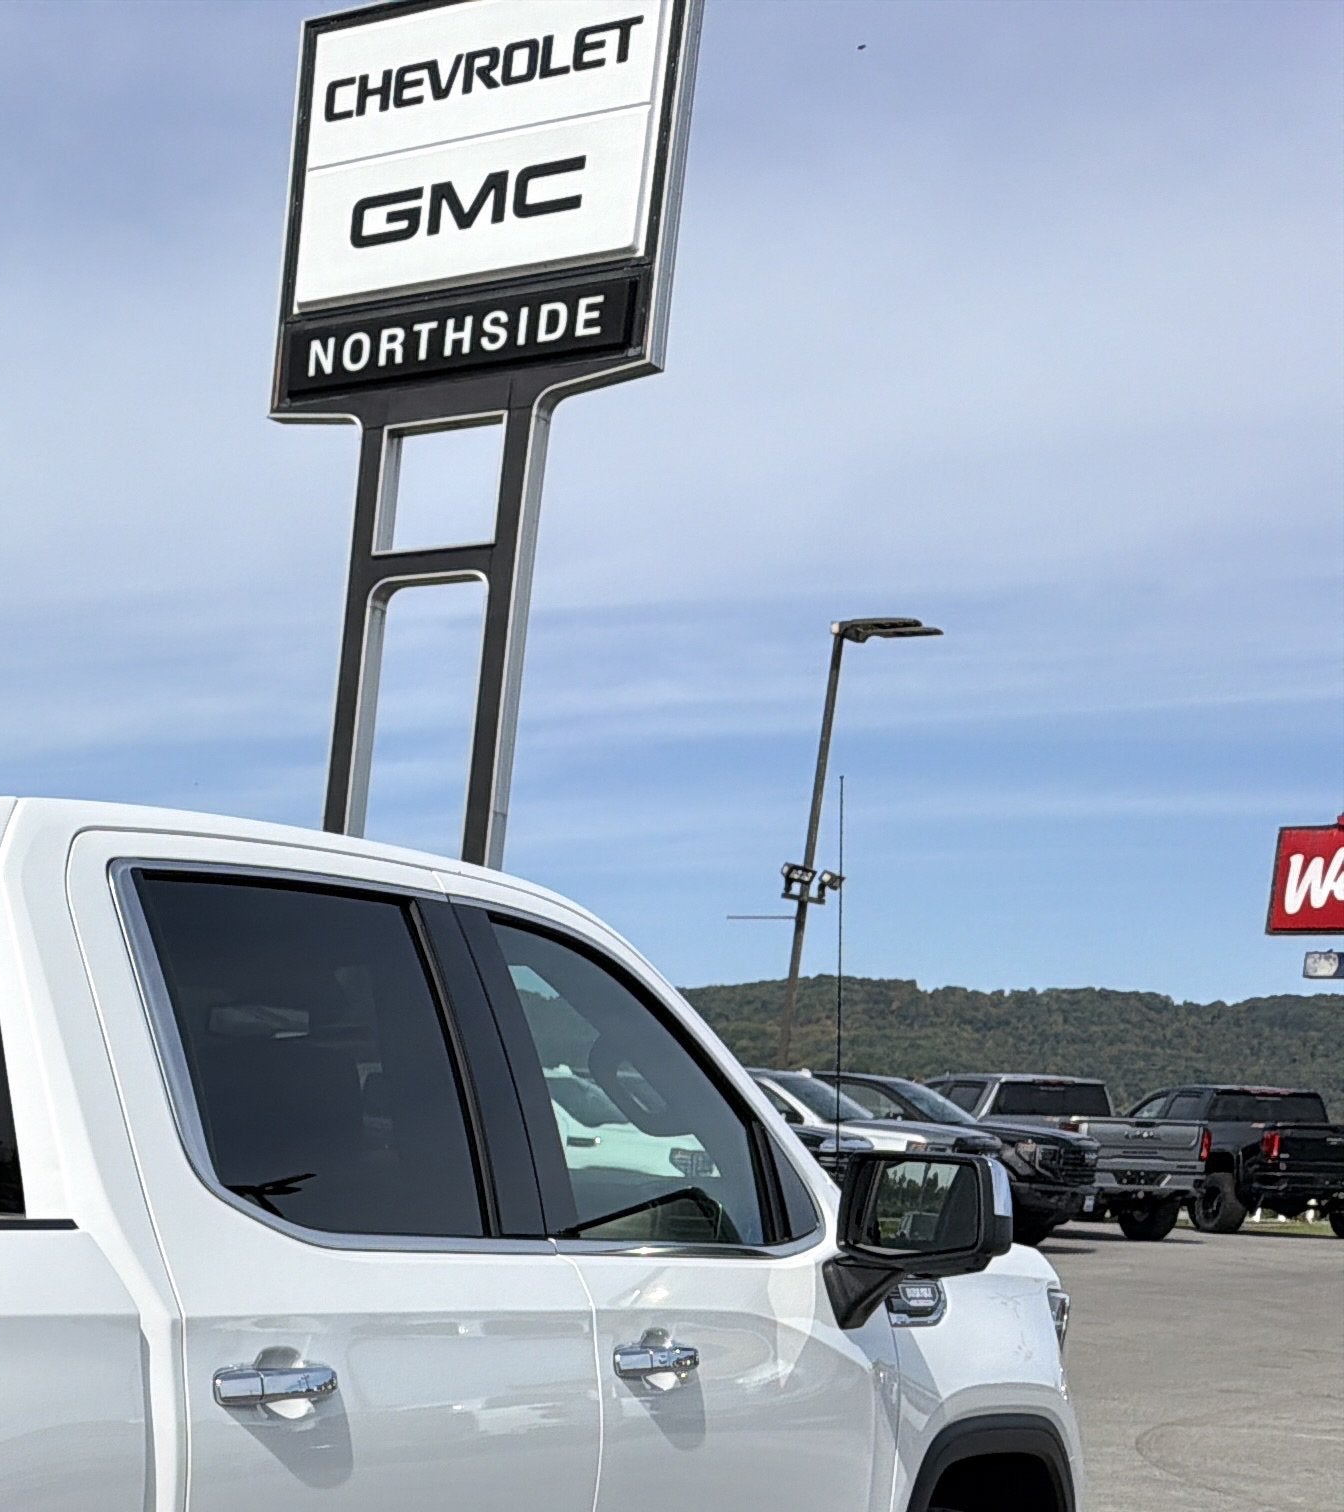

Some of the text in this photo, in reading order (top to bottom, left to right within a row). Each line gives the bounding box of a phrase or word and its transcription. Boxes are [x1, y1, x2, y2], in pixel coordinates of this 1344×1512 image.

[324, 15, 645, 123] CHEVROLET
[350, 154, 587, 249] GMC
[307, 295, 605, 378] NORTHSIDE
